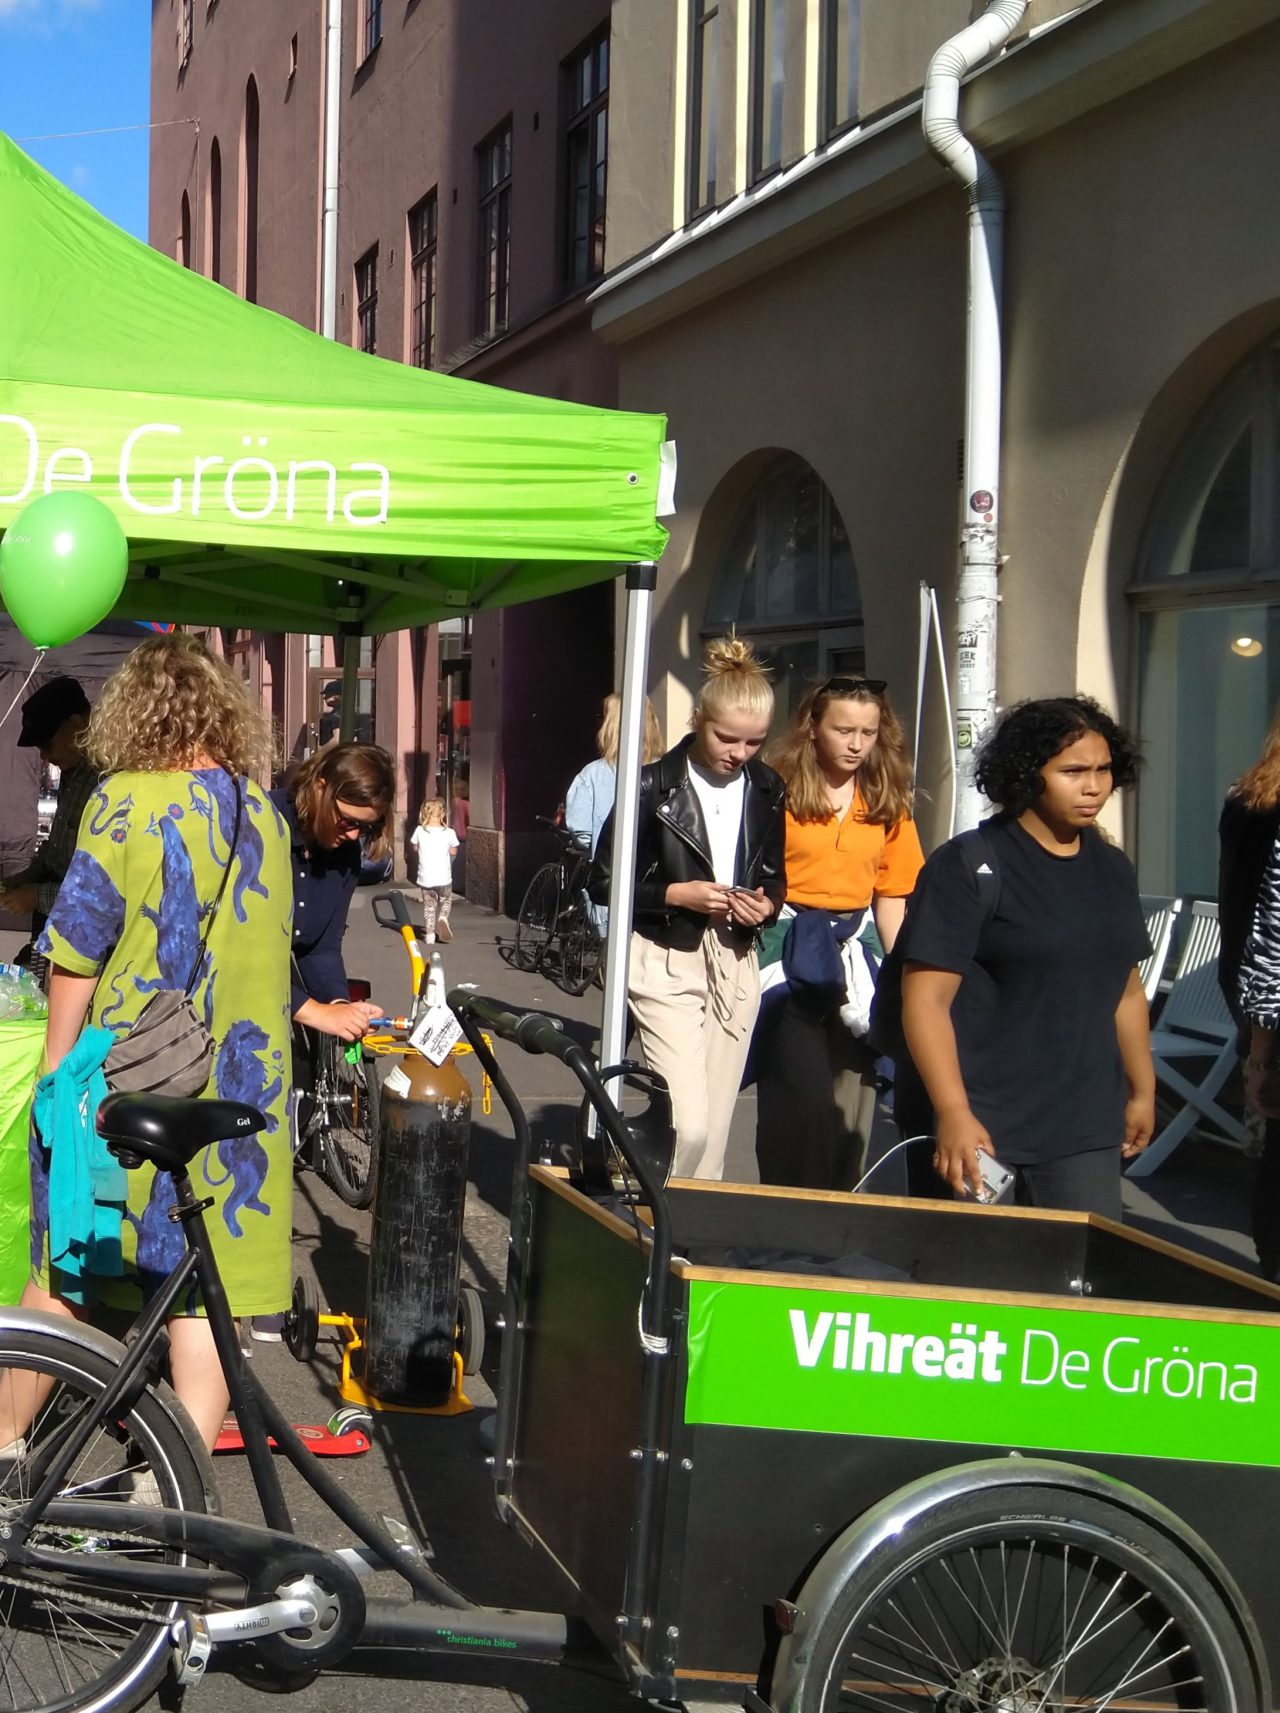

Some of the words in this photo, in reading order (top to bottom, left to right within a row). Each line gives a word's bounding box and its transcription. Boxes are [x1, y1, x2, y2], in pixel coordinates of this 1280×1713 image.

[119, 422, 391, 525] Gröna
[236, 1117, 251, 1126] Gel
[788, 1309, 1008, 1383] Vihreät
[1020, 1328, 1091, 1390] De
[1102, 1336, 1259, 1404] Gröna
[999, 1513, 1067, 1523] SCHWALBE
[1114, 1535, 1150, 1555] PLUS
[447, 1634, 492, 1647] christiania
[493, 1638, 518, 1649] bikes
